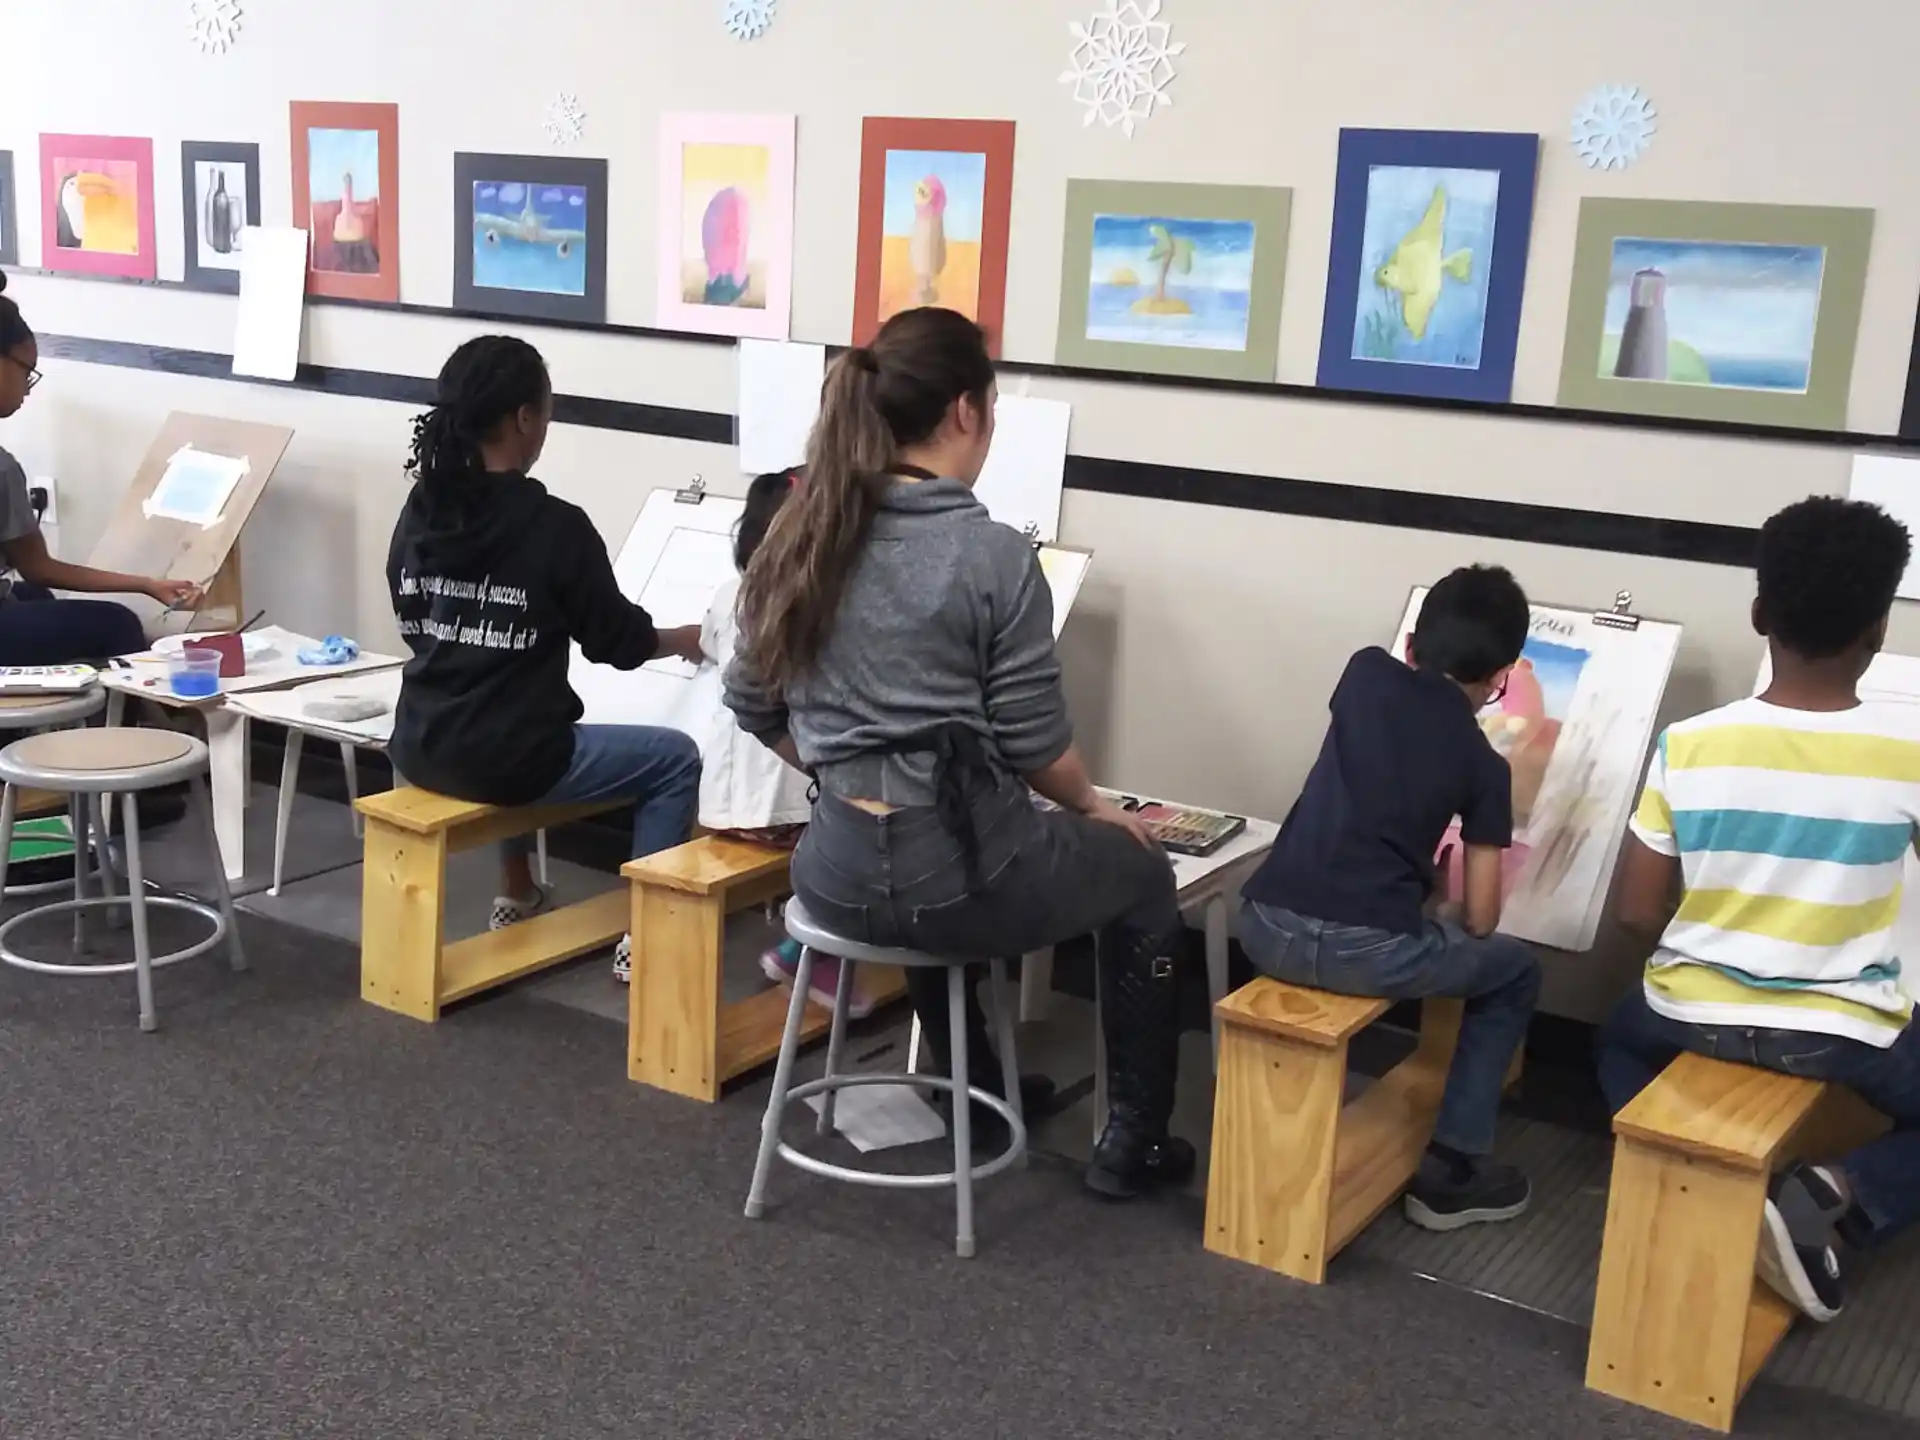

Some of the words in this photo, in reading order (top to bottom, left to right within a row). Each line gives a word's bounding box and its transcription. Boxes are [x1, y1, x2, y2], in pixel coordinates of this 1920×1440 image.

[477, 573, 490, 610] of
[488, 585, 528, 612] success,
[436, 614, 461, 641] and
[459, 619, 484, 646] work
[484, 620, 514, 648] hard
[513, 627, 527, 649] at
[528, 627, 538, 648] it
